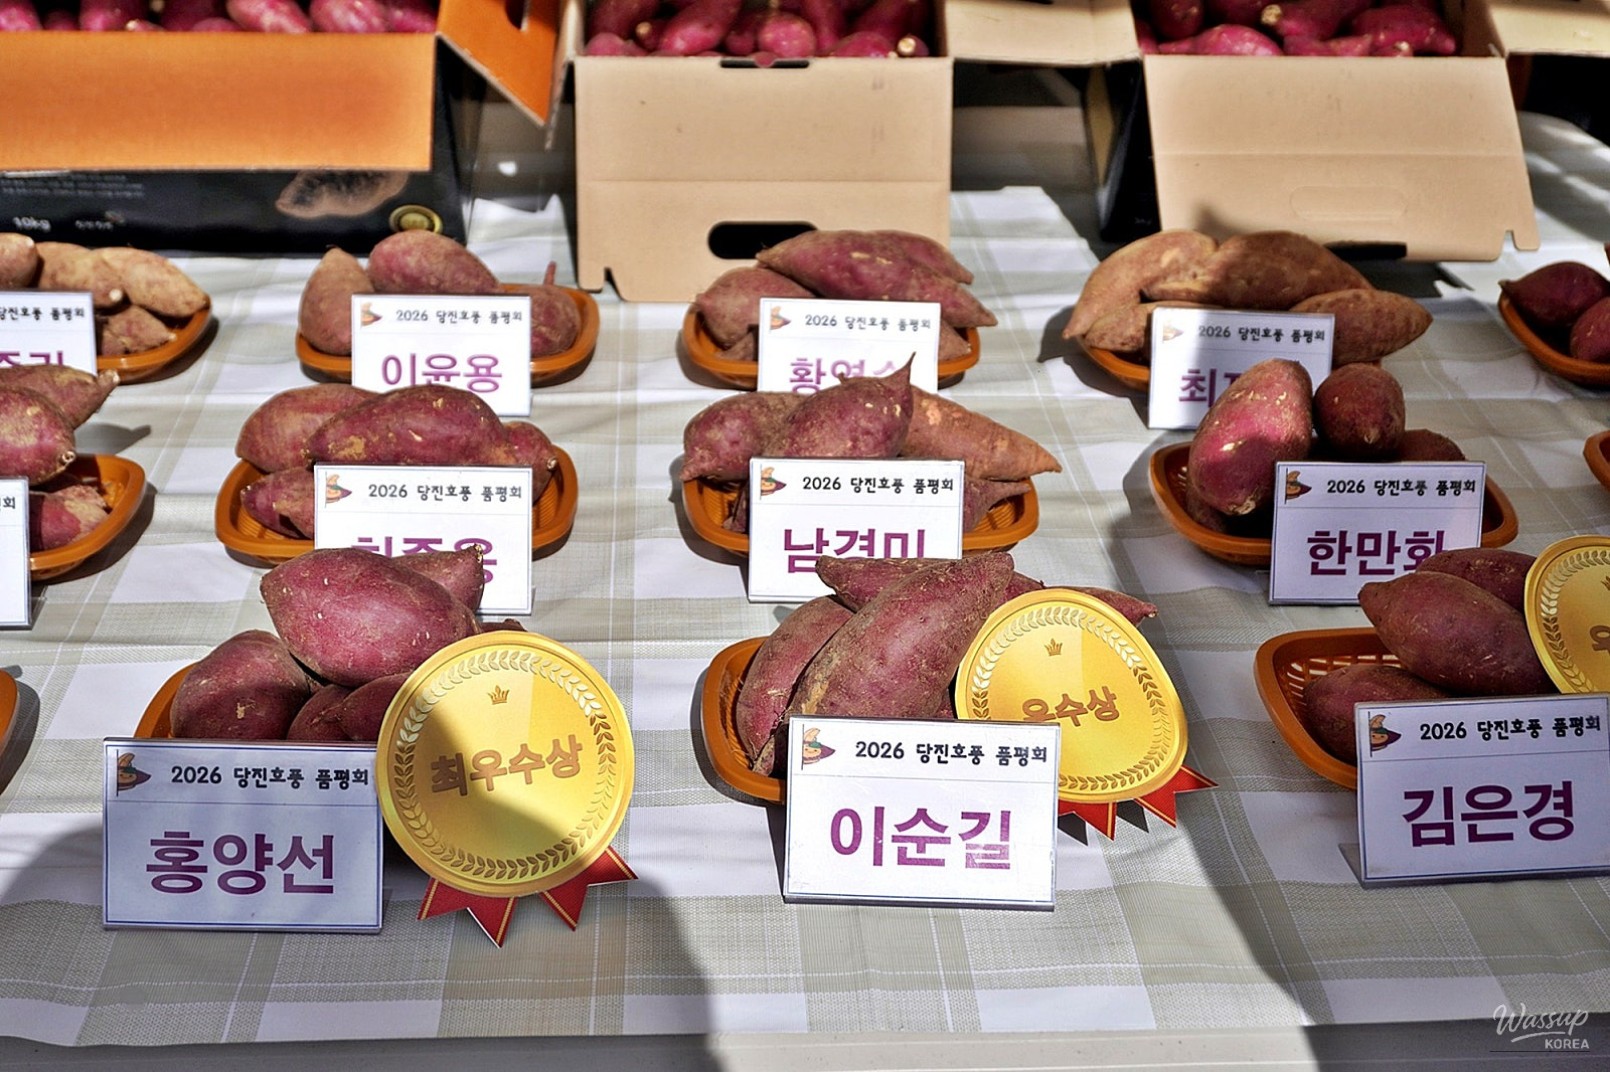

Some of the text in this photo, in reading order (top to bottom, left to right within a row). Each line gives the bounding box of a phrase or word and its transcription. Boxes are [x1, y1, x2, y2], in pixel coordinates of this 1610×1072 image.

[396, 309, 429, 322] 2026
[435, 310, 481, 325] 당진호풍
[805, 314, 838, 327] 2026
[844, 316, 890, 331] 당진호풍
[1197, 323, 1233, 340] 2026
[1237, 327, 1284, 343] 당진호풍
[368, 483, 522, 503] 2026 당진호풍 품평회
[802, 476, 954, 495] 2026 당진호풍 품평회
[1326, 478, 1476, 497] 2026 당진호풍 품평회
[1306, 530, 1445, 576] 한만회
[1419, 715, 1601, 742] 2026 당진호풍 품평회
[430, 734, 585, 796] 최우수상
[855, 740, 1047, 768] 2026 당진호풍 품평회
[171, 765, 369, 791] 2026 당진호풍 품평회
[1402, 780, 1575, 848] 김은경
[830, 805, 1012, 870] 이순길
[145, 830, 335, 896] 홍양선
